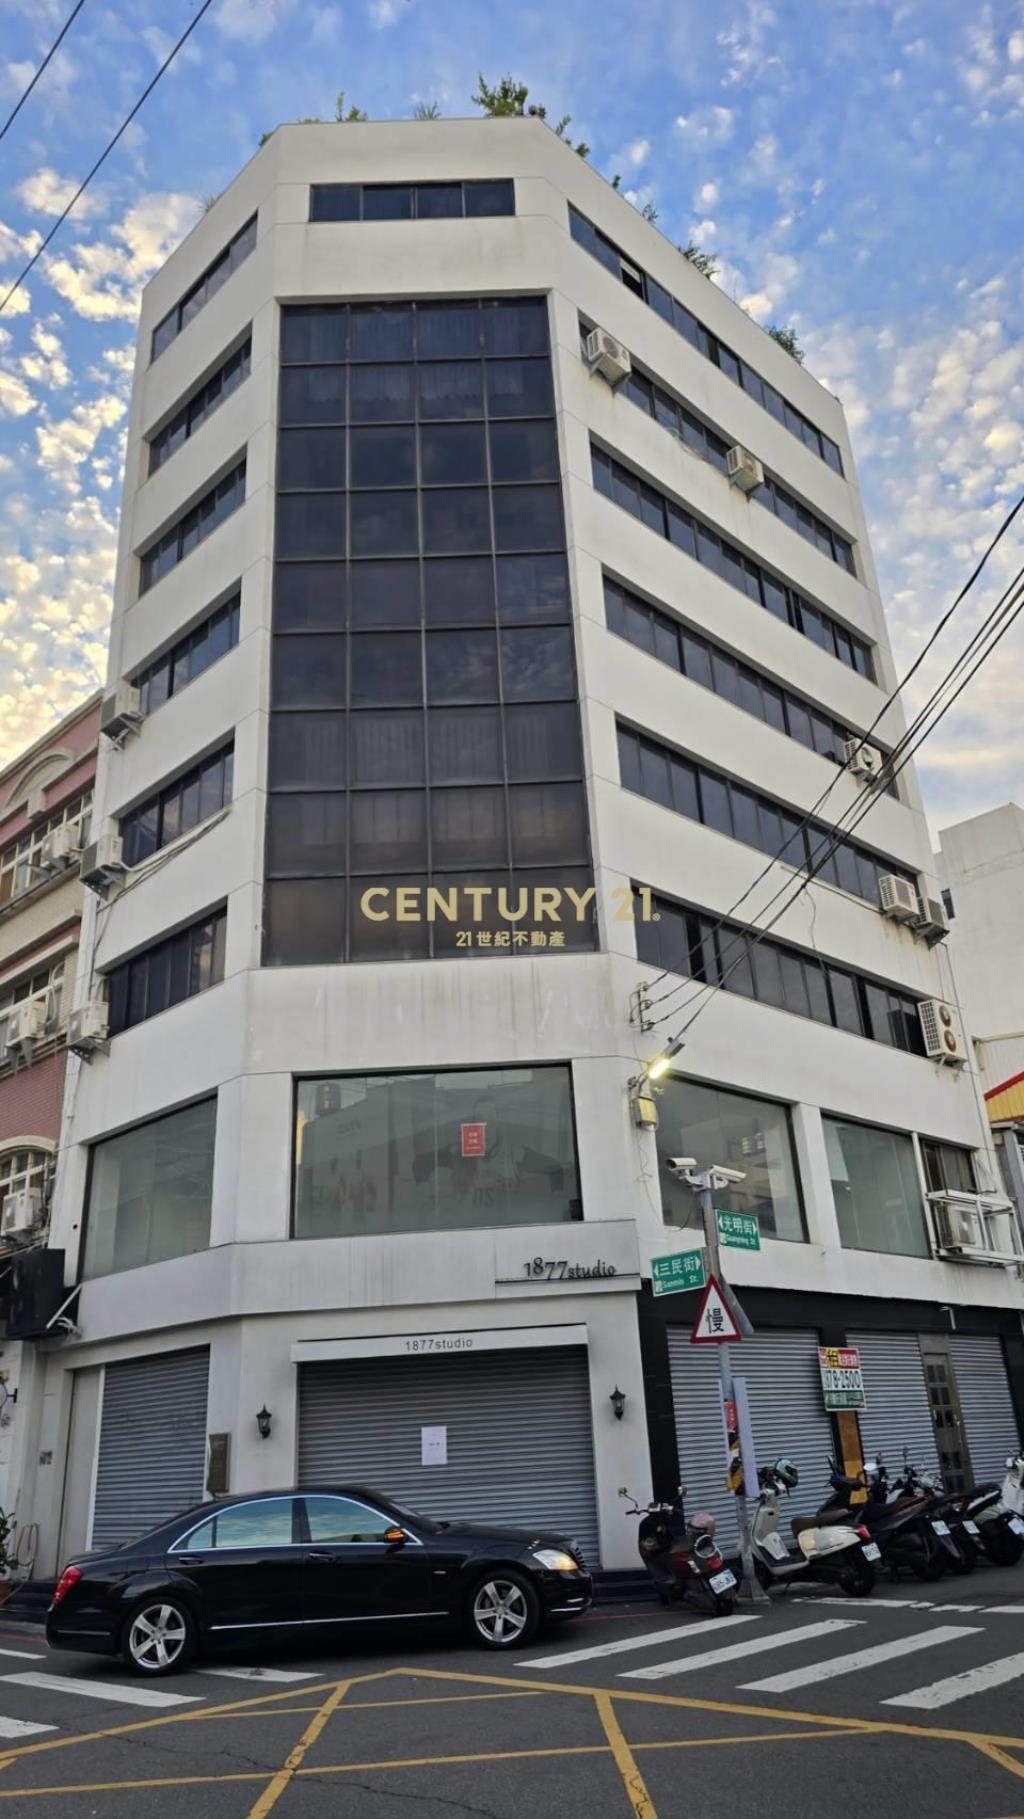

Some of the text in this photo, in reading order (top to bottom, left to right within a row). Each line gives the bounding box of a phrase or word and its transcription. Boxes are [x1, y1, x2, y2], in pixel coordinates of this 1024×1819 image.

[723, 1216, 753, 1234] 光明街
[523, 1257, 616, 1279] 1877studio
[659, 1257, 696, 1276] 三民街
[705, 1308, 725, 1334] 慢
[405, 1338, 473, 1351] 1877studio
